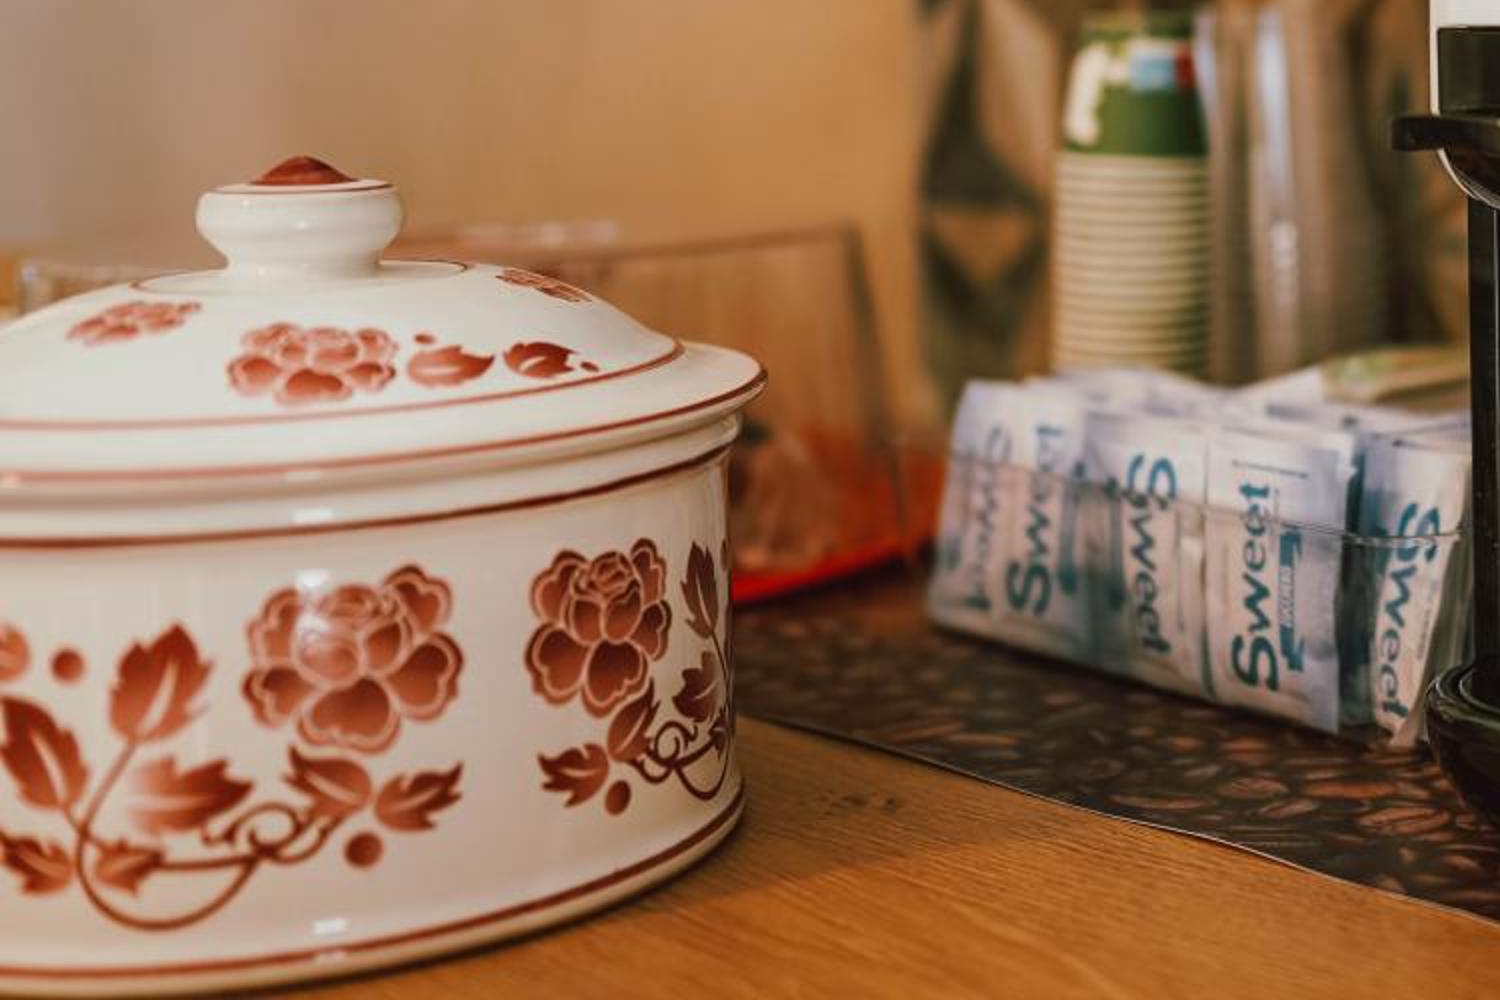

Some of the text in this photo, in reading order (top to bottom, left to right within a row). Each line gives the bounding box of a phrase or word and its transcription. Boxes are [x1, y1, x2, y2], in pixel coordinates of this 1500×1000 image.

[1125, 453, 1177, 654] Sweet
[1232, 482, 1280, 692] Sweet
[1379, 502, 1441, 718] Sweet
